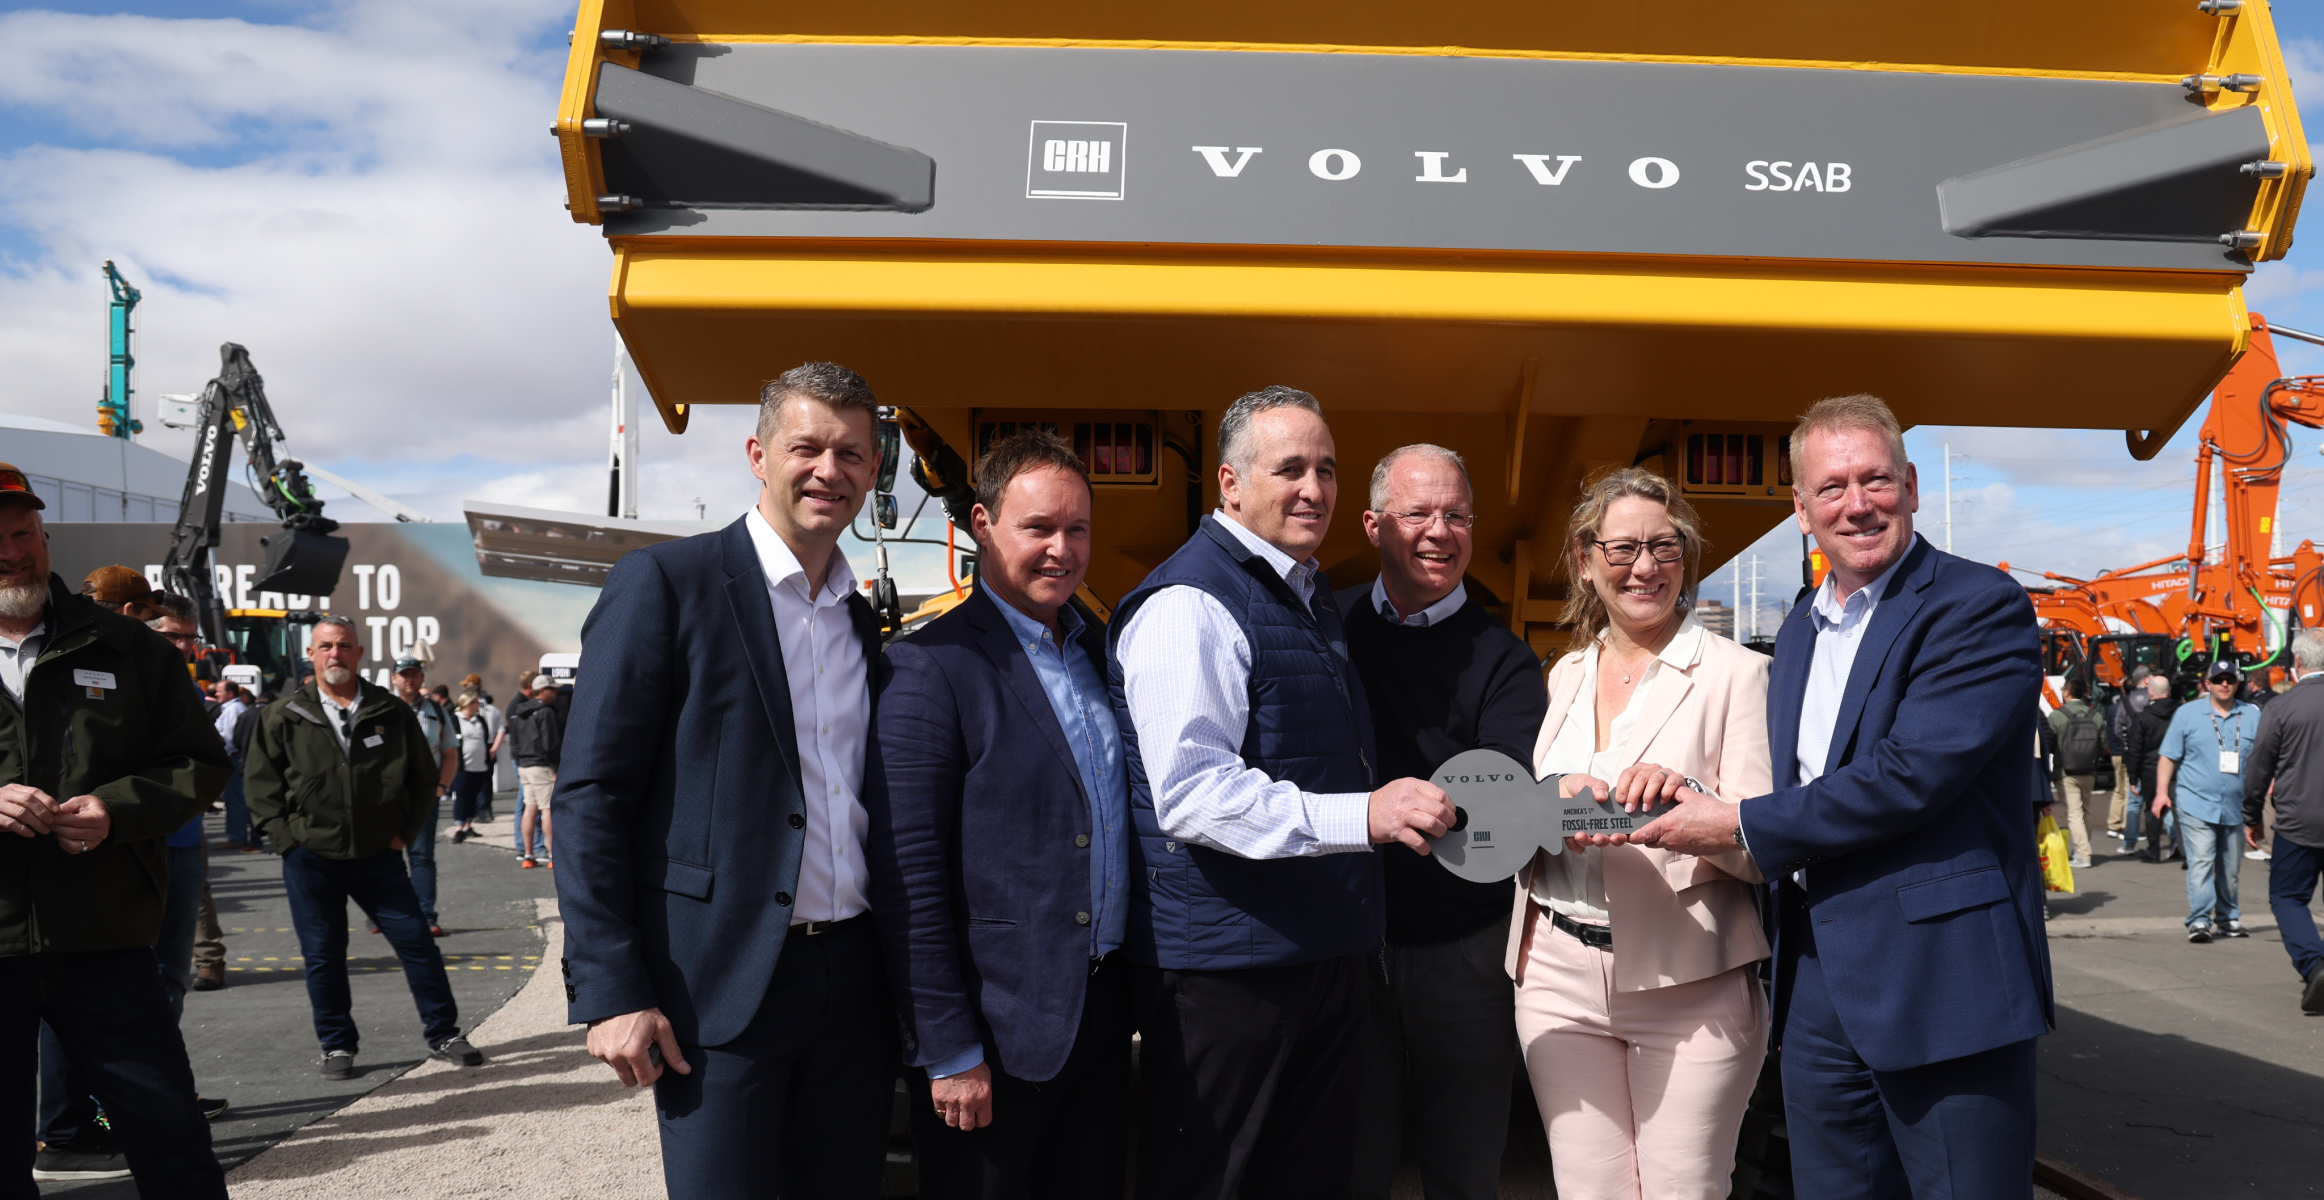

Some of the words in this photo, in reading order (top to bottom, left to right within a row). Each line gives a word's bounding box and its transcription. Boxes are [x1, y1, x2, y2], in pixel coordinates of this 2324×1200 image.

[1043, 139, 1111, 173] CRH
[1192, 145, 1680, 190] VOLVO
[1744, 160, 1852, 193] SSAB
[195, 425, 218, 496] VOLVO
[352, 564, 401, 610] TO
[1442, 773, 1515, 784] VOLVO
[1563, 807, 1588, 815] AMERICA'S
[1562, 818, 1609, 831] FOSSIL-FREE
[1610, 817, 1634, 829] STEEL
[1473, 830, 1491, 842] CRH
